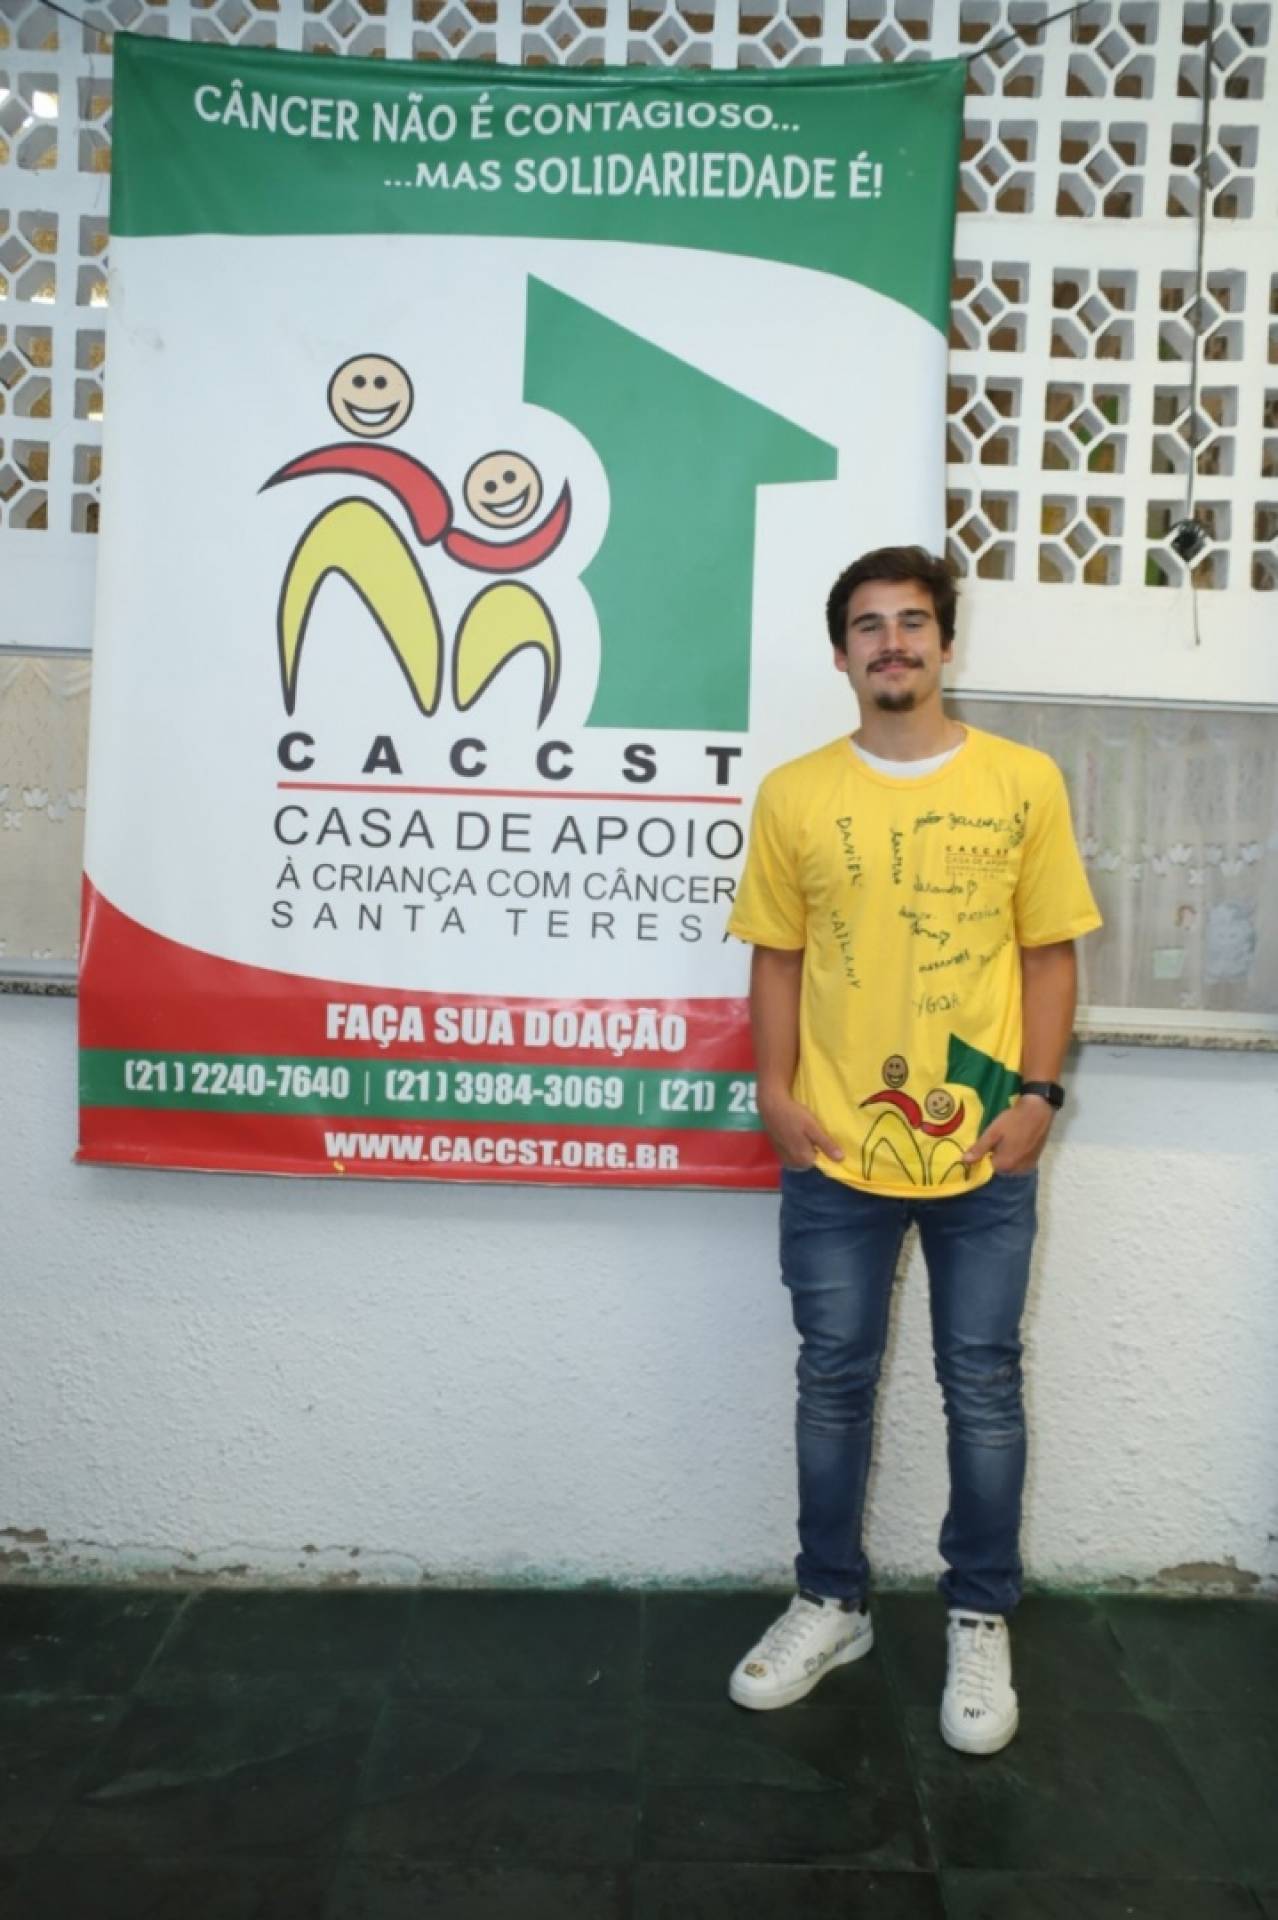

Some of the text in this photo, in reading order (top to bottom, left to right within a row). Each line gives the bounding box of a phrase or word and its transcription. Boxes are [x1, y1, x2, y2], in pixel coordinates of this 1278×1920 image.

[195, 80, 798, 141] CÂNCER NÃO É CONTAGIOSO...
[515, 152, 835, 198] SOLIDARIEDADE
[850, 152, 882, 197] É!
[277, 732, 742, 785] CACCST
[274, 805, 743, 859] CASA DE APOIO
[277, 857, 735, 904] À CRIANÇA COM CÂNCER
[271, 900, 464, 934] SANTA
[327, 1004, 687, 1055] FAÇA SUA DOAÇÃO
[192, 1063, 349, 1098] 2240-7640
[455, 1072, 623, 1108] 3984-3069
[660, 1079, 714, 1110] (21)
[325, 1132, 679, 1170] WWW.CACCST.ORG.BR
